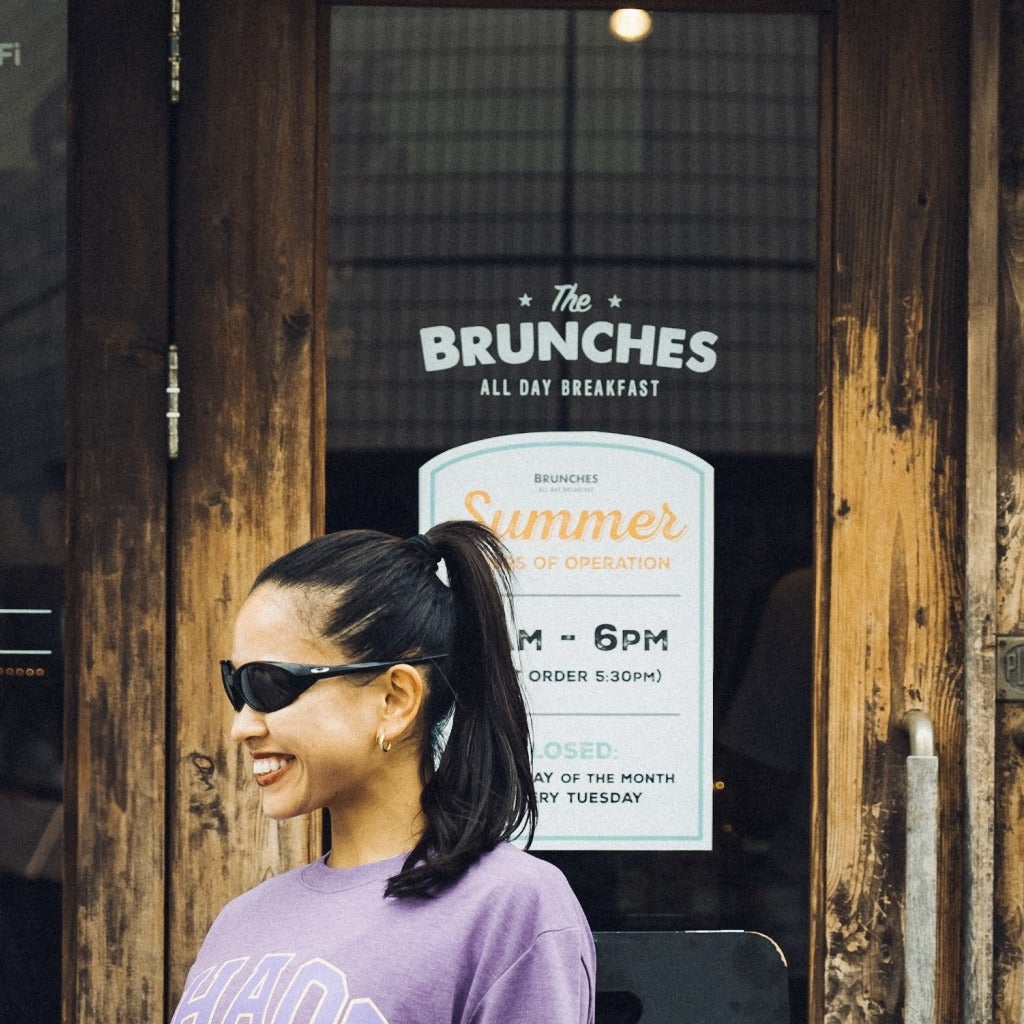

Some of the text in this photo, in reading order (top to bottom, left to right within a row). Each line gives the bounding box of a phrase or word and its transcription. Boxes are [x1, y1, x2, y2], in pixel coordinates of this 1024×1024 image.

[551, 283, 592, 313] The
[419, 321, 719, 373] BRUNCHES
[480, 379, 660, 397] ALL DAY BREAKFAST
[534, 473, 599, 484] BRUNCHES
[533, 556, 558, 570] OF
[565, 556, 671, 570] OPERATION
[594, 623, 669, 651] 6PM
[529, 670, 588, 682] ORDER
[533, 741, 619, 760] LOSED:
[534, 772, 675, 784] AY OF THE MONTH
[536, 791, 643, 804] RY TUESDAY
